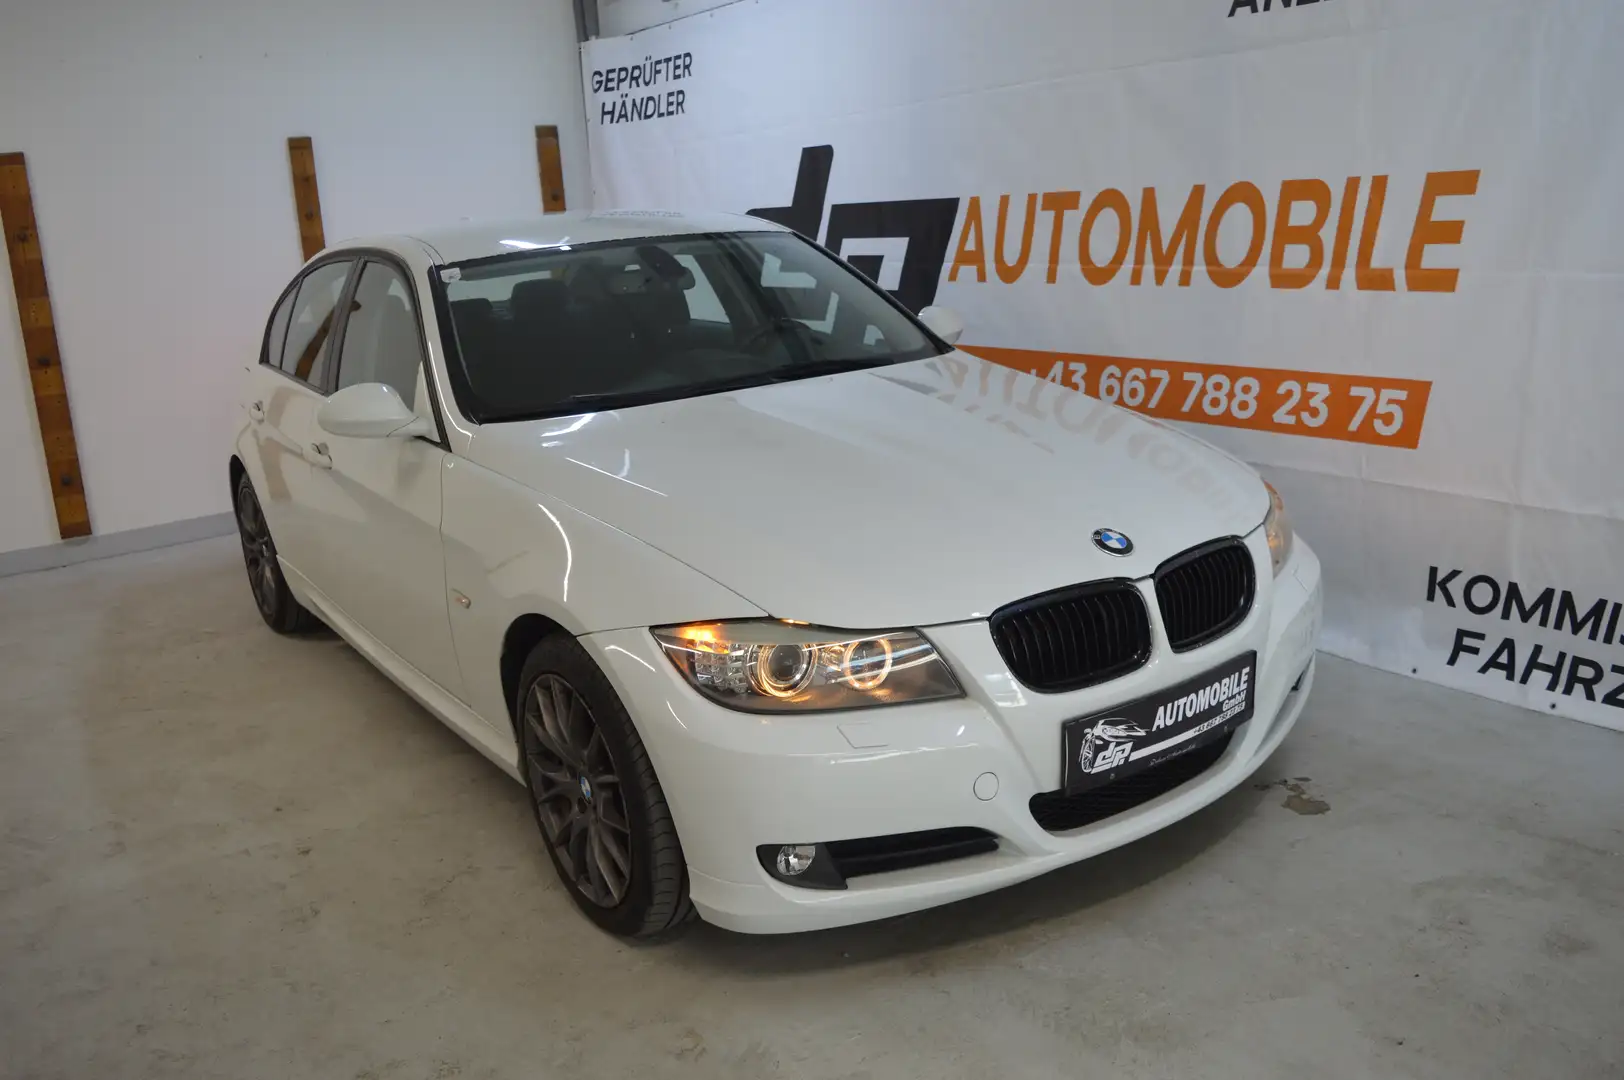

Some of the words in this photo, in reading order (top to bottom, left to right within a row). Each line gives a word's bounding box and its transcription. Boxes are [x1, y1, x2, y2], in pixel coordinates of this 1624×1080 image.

[592, 52, 692, 93] GEPRÜFTER
[601, 90, 686, 125] HÄNDLER
[947, 169, 1481, 293] AUTOMOBILE
[1099, 364, 1170, 407] 667
[1180, 372, 1260, 420] 788
[1272, 380, 1331, 428] 23
[1347, 386, 1408, 436] 75
[1426, 566, 1624, 645] KOMMI
[1152, 667, 1250, 731] AUTOMOBILE
[1222, 689, 1247, 711] GmbH
